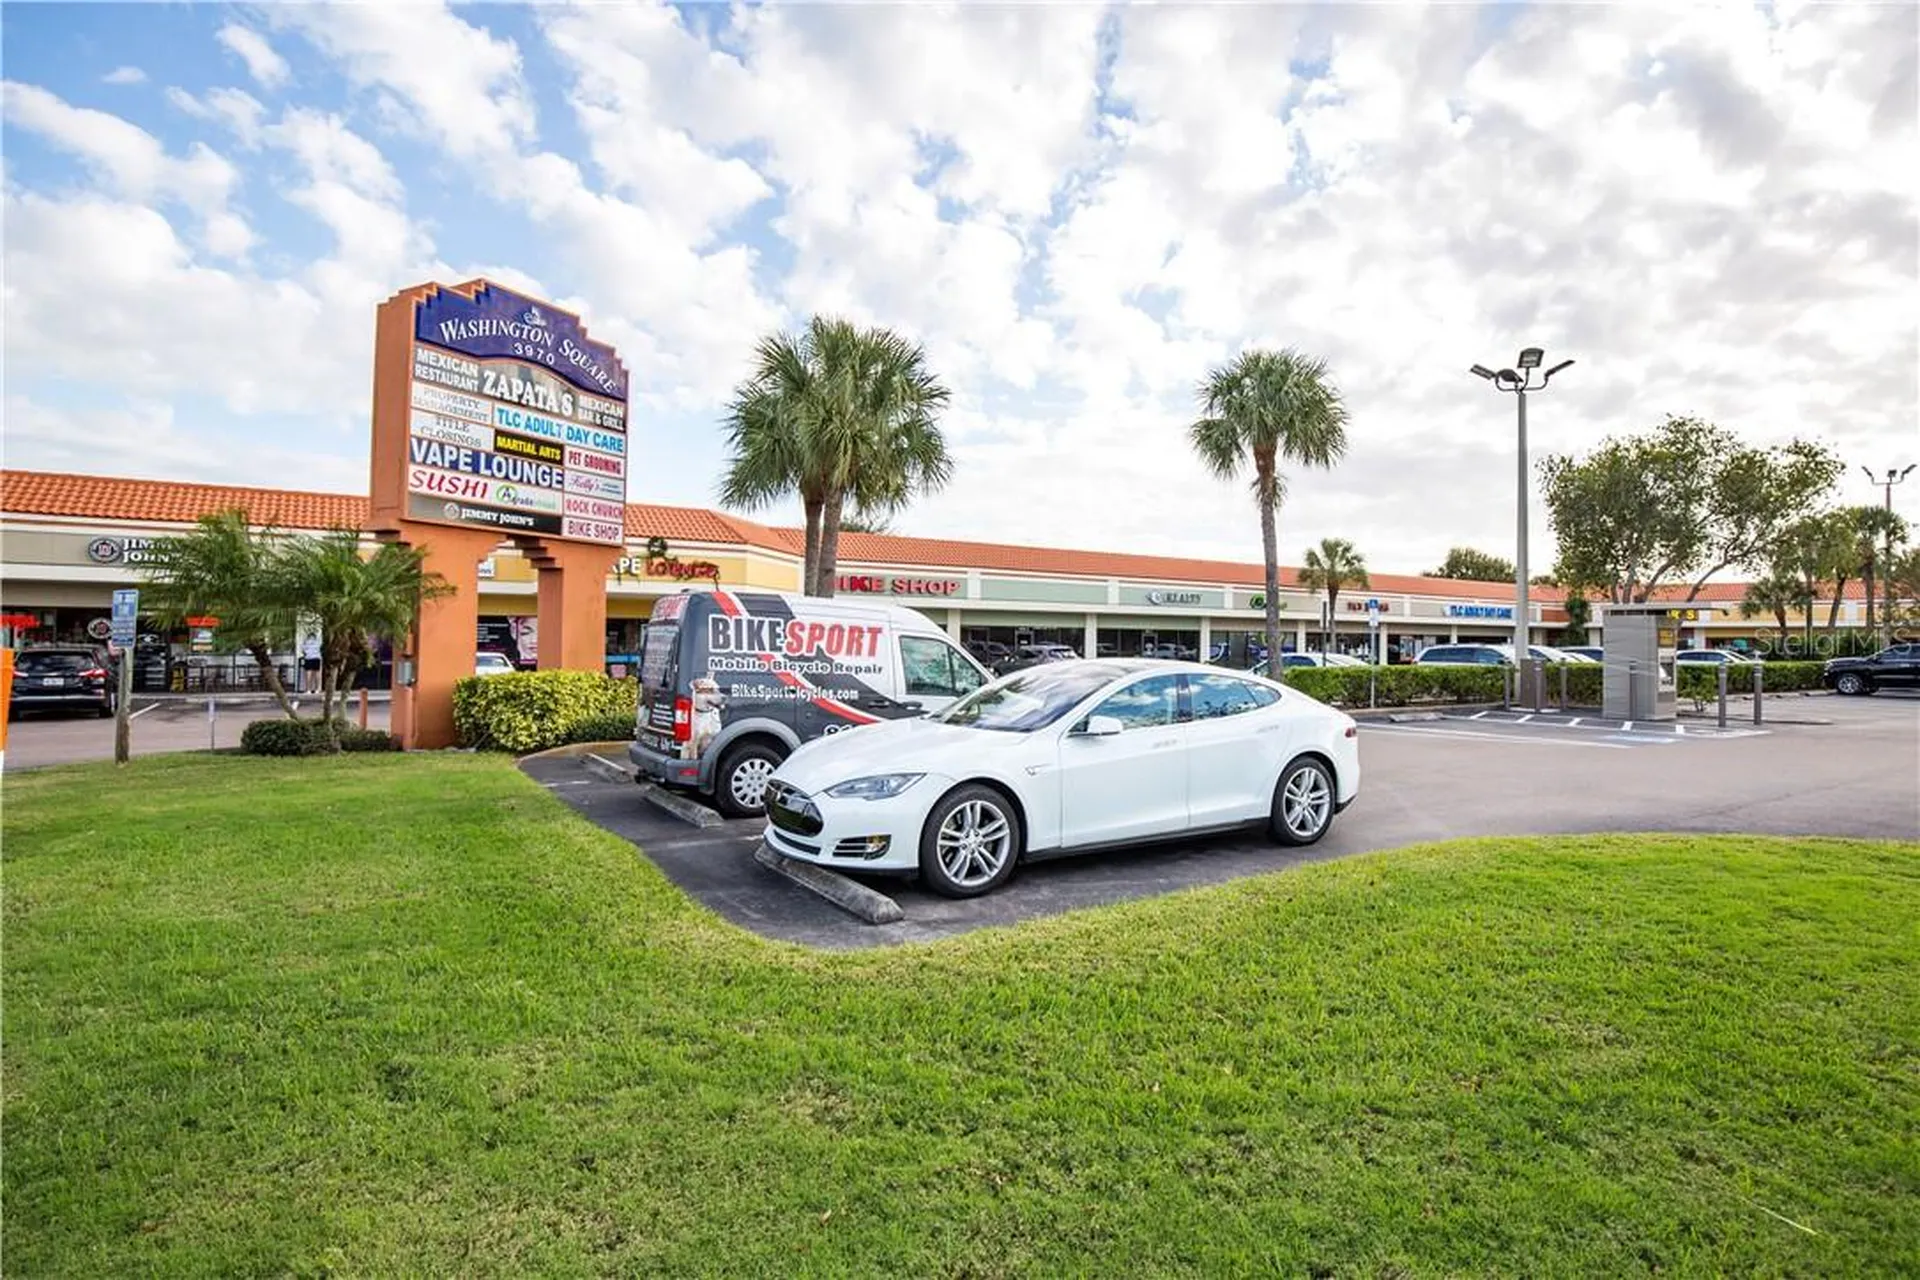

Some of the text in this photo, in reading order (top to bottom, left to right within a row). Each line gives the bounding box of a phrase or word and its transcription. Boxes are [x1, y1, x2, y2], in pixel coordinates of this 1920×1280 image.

[416, 347, 479, 378] MEXICAN
[439, 317, 617, 394] WASHINGTON SQUARE
[513, 341, 556, 366] 3970
[414, 363, 479, 393] RESTAURANT
[482, 369, 574, 418] ZAPATA'S
[579, 394, 624, 418] MEXICAN
[435, 413, 471, 434] TITLE
[496, 407, 624, 453] TLC ADULT DAY CARE
[602, 414, 624, 431] GRILL
[420, 424, 482, 448] CLOSINGS
[496, 435, 562, 461] MARTIAL ARTS
[411, 438, 564, 489] VAPE LOUNGE
[568, 450, 581, 466] PET
[410, 469, 489, 499] SUSHI
[461, 507, 535, 526] JIMMY JOHN'S
[566, 499, 590, 515] ROCK
[592, 502, 624, 519] CHURCH
[568, 520, 619, 540] BIKE SHOP
[123, 538, 173, 551] JIMM
[891, 577, 961, 596] SHOP
[709, 657, 884, 676] Mobile Bicycle Repair
